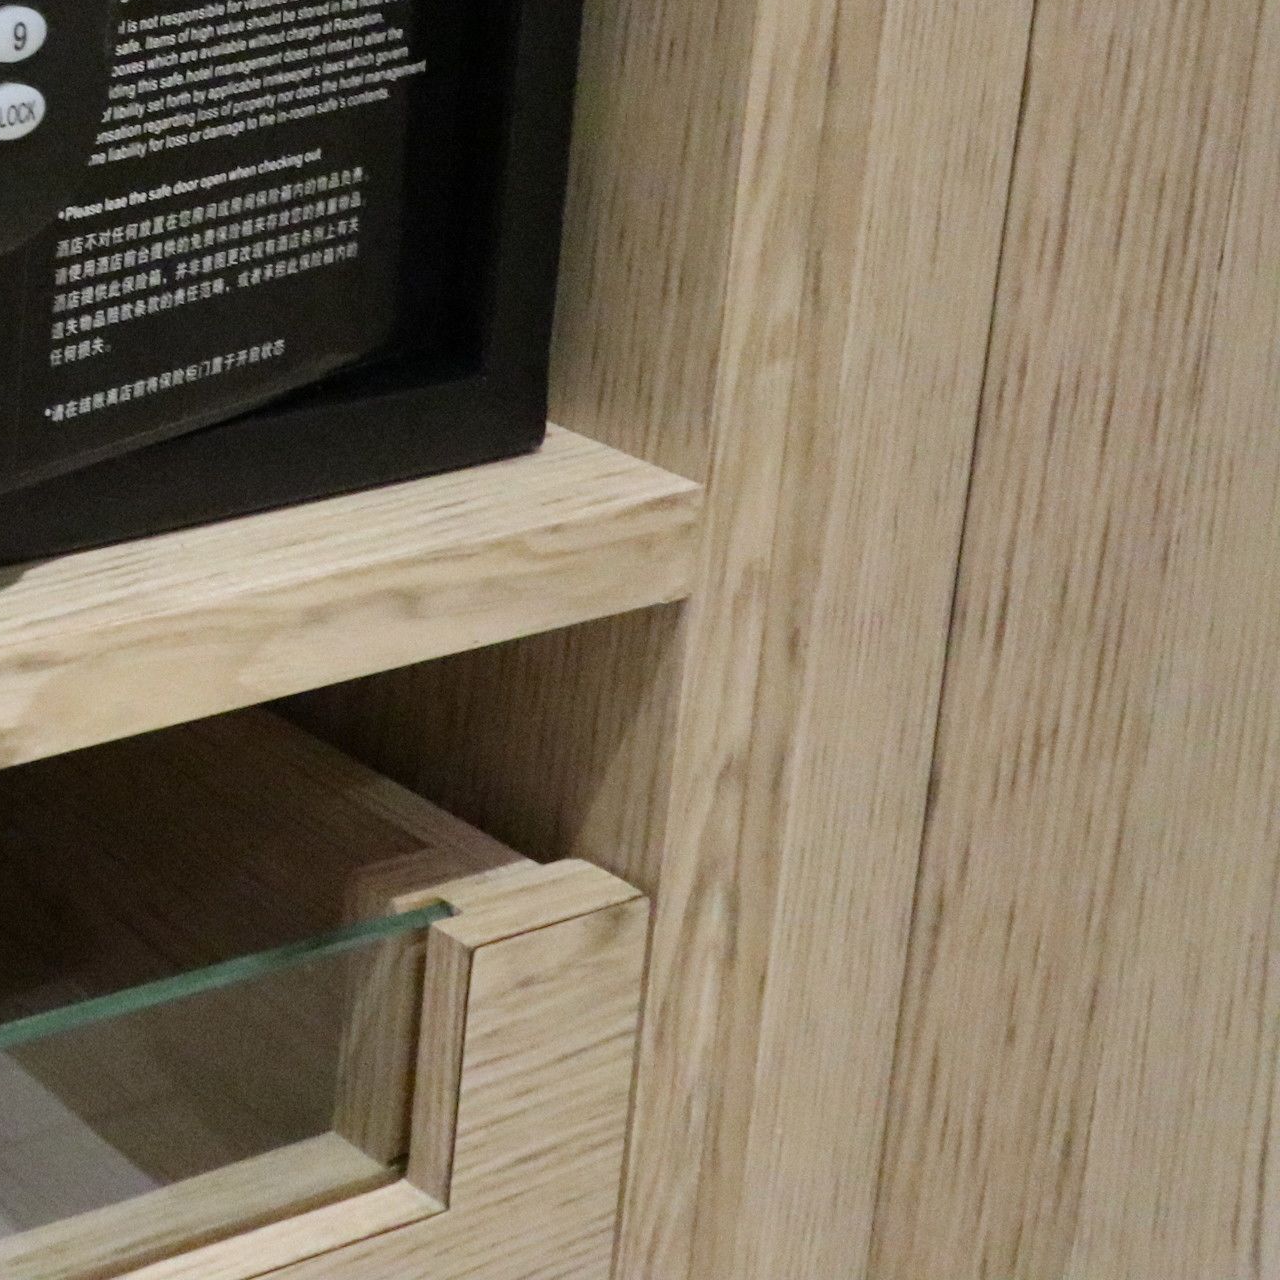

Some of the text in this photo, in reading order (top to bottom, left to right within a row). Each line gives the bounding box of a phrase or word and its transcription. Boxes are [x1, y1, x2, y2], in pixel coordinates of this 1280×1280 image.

[13, 22, 27, 51] 9
[127, 20, 138, 32] is
[139, 15, 158, 30] not
[160, 3, 225, 26] responsible
[227, 0, 243, 13] for
[178, 28, 190, 43] of
[191, 25, 214, 42] high
[216, 21, 245, 36] value
[246, 11, 281, 30] should
[283, 10, 296, 22] be
[297, 2, 330, 20] stored
[138, 79, 158, 93] this
[160, 72, 184, 89] safe
[184, 65, 213, 83] hotel
[215, 52, 283, 77] management
[282, 48, 309, 62] does
[309, 43, 327, 56] not
[352, 36, 364, 48] to
[147, 52, 178, 69] which
[180, 50, 198, 63] are
[199, 39, 247, 59] available
[248, 30, 285, 48] without
[286, 25, 322, 41] charge
[143, 113, 196, 134] regarding
[196, 107, 219, 121] loss
[220, 101, 233, 116] of
[295, 85, 320, 99] does
[322, 80, 338, 93] the
[339, 73, 364, 89] hotel
[147, 97, 165, 112] set
[193, 90, 206, 104] by
[345, 53, 374, 69] which
[149, 138, 165, 151] for
[166, 134, 188, 148] loss
[189, 131, 202, 143] or
[201, 121, 246, 140] damage
[247, 118, 257, 129] to
[259, 113, 276, 127] the
[64, 203, 103, 220] Please
[129, 192, 147, 205] the
[149, 184, 172, 200] safe
[173, 179, 200, 194] door
[199, 173, 227, 189] open
[228, 166, 256, 180] when
[258, 154, 303, 174] checking
[304, 148, 321, 162] out
